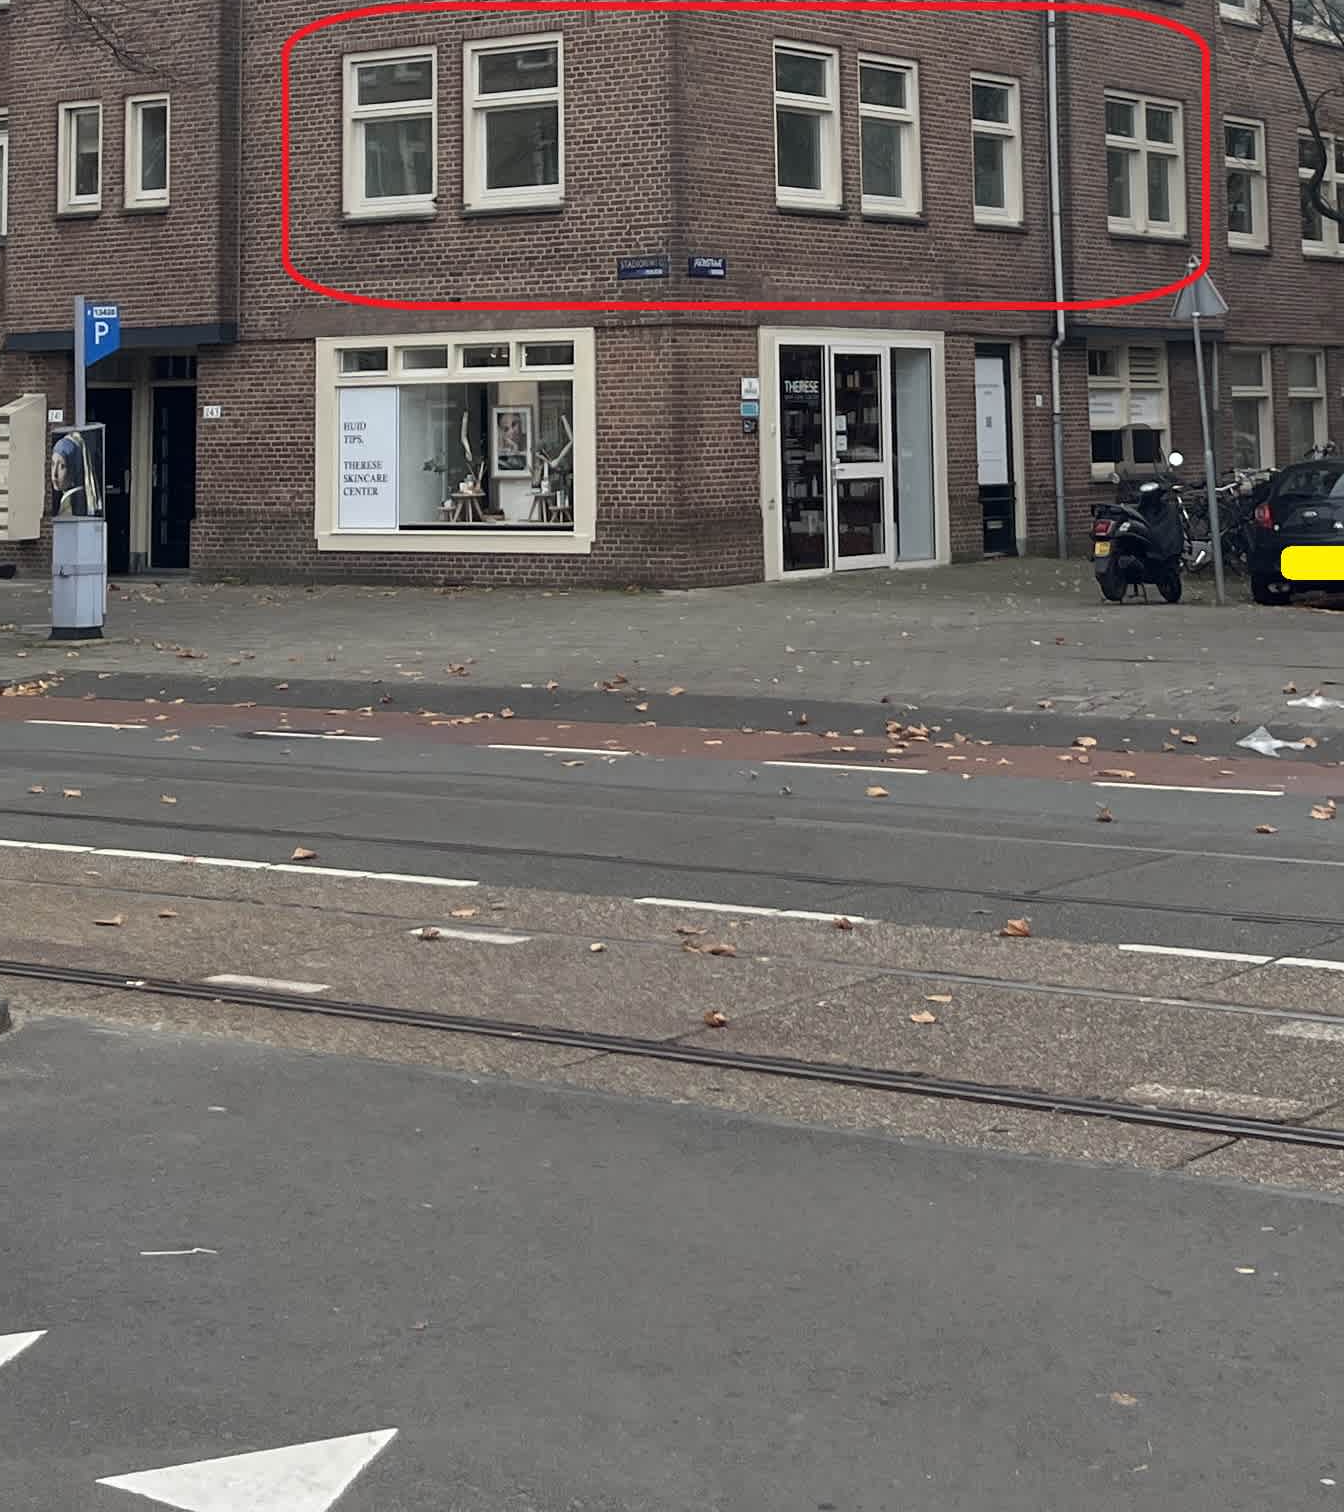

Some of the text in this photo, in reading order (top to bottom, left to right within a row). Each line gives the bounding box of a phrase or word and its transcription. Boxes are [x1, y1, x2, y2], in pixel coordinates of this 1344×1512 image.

[95, 321, 109, 345] P
[784, 380, 820, 393] THERESE
[343, 422, 367, 431] HUID
[343, 460, 383, 470] THERESE
[343, 473, 388, 483] SKINCARE
[343, 486, 378, 496] CENTER
